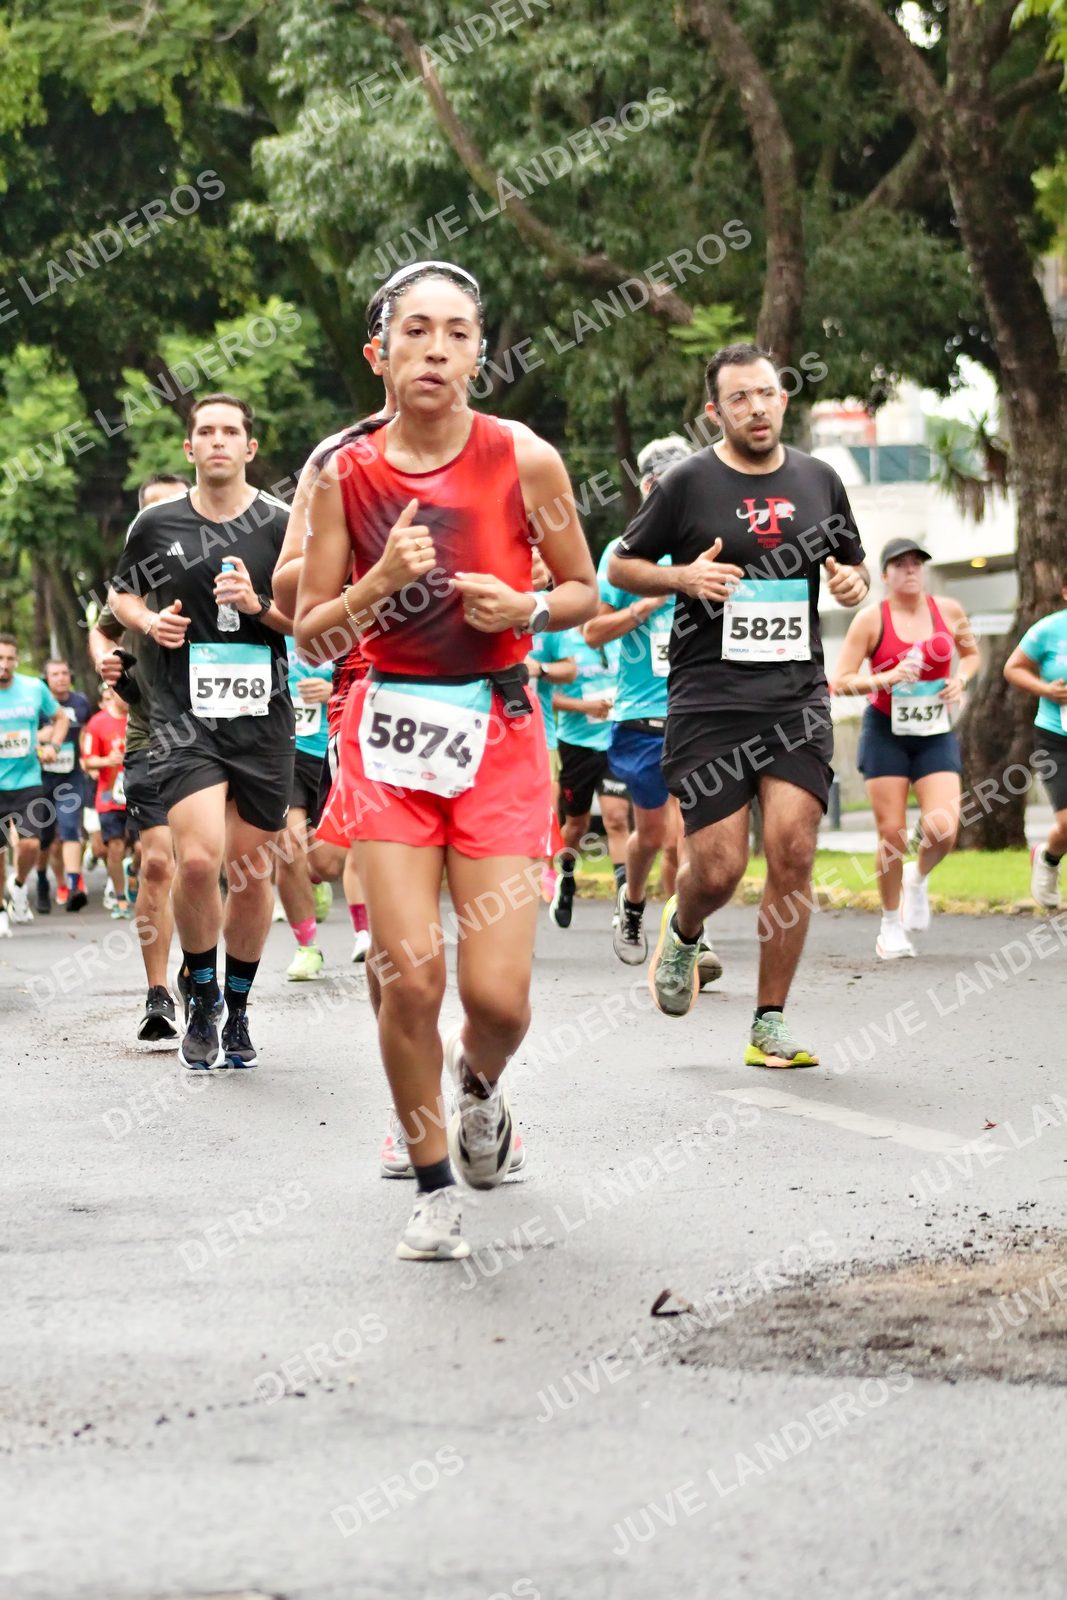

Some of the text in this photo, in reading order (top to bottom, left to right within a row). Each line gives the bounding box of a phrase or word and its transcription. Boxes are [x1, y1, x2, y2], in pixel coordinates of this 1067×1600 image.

[730, 616, 802, 641] 5825
[196, 677, 266, 699] 5768
[897, 703, 944, 723] 3437
[366, 711, 473, 769] 5874
